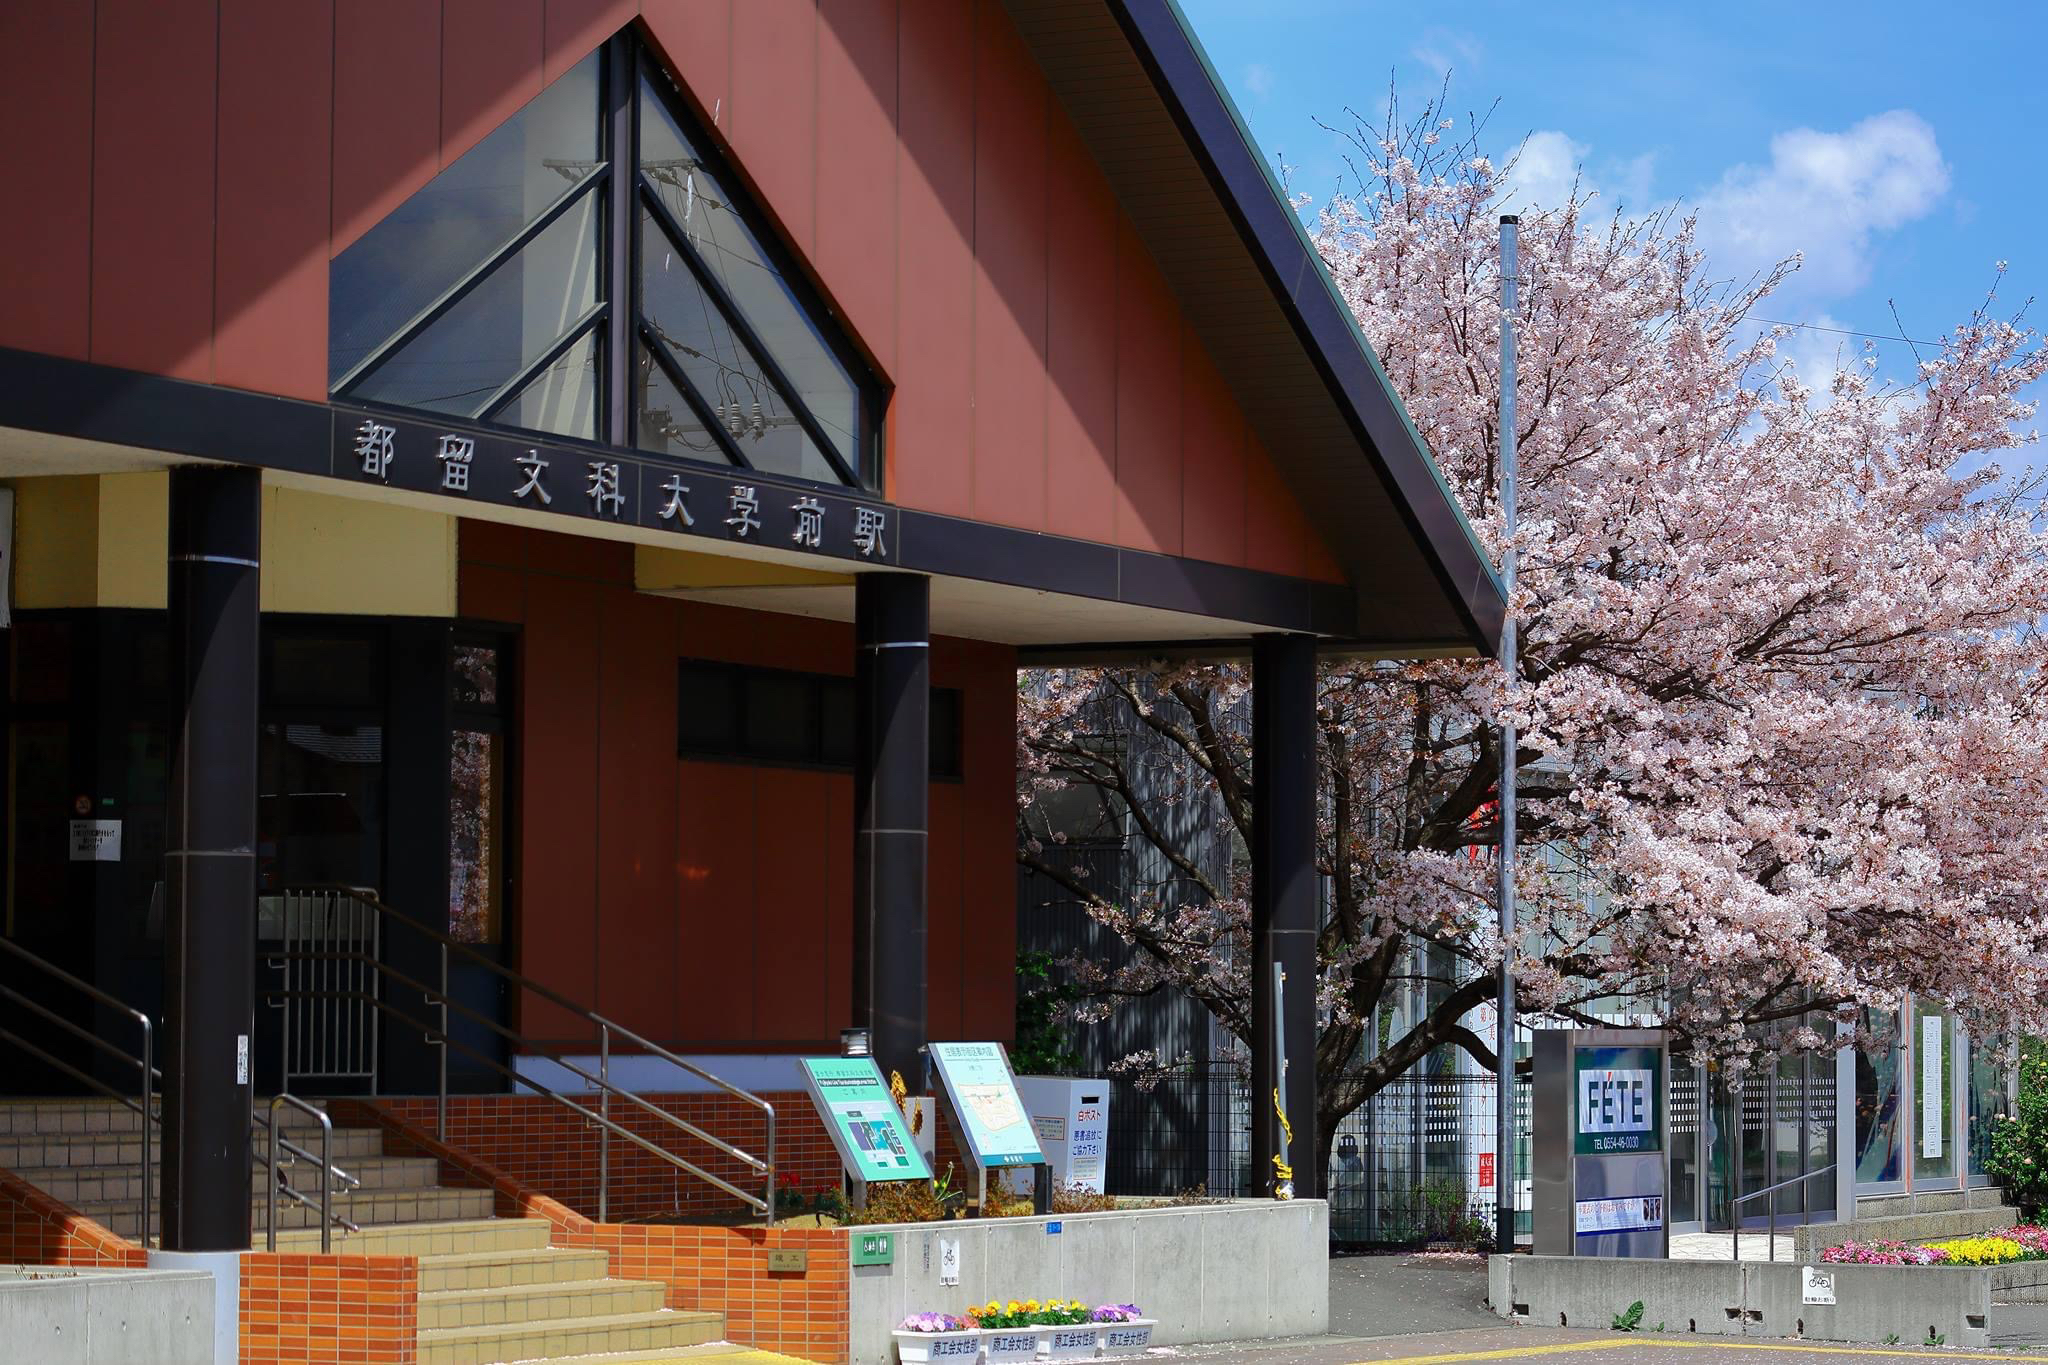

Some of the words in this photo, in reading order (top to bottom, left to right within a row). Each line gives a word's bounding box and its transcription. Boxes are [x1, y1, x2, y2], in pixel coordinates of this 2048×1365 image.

[354, 420, 887, 557] 都留文科大学前駅
[1077, 1110, 1101, 1121] 白ポスト
[1073, 1130, 1102, 1141] 悪書追放に
[1072, 1144, 1102, 1156] ご協力下さい
[1594, 1139, 1603, 1150] TEL
[932, 1337, 978, 1357] 商工会女性部
[992, 1336, 1036, 1353] 商工会女性部
[1055, 1332, 1096, 1349] 商工会女性部
[1108, 1332, 1149, 1347] 商工会女性部
